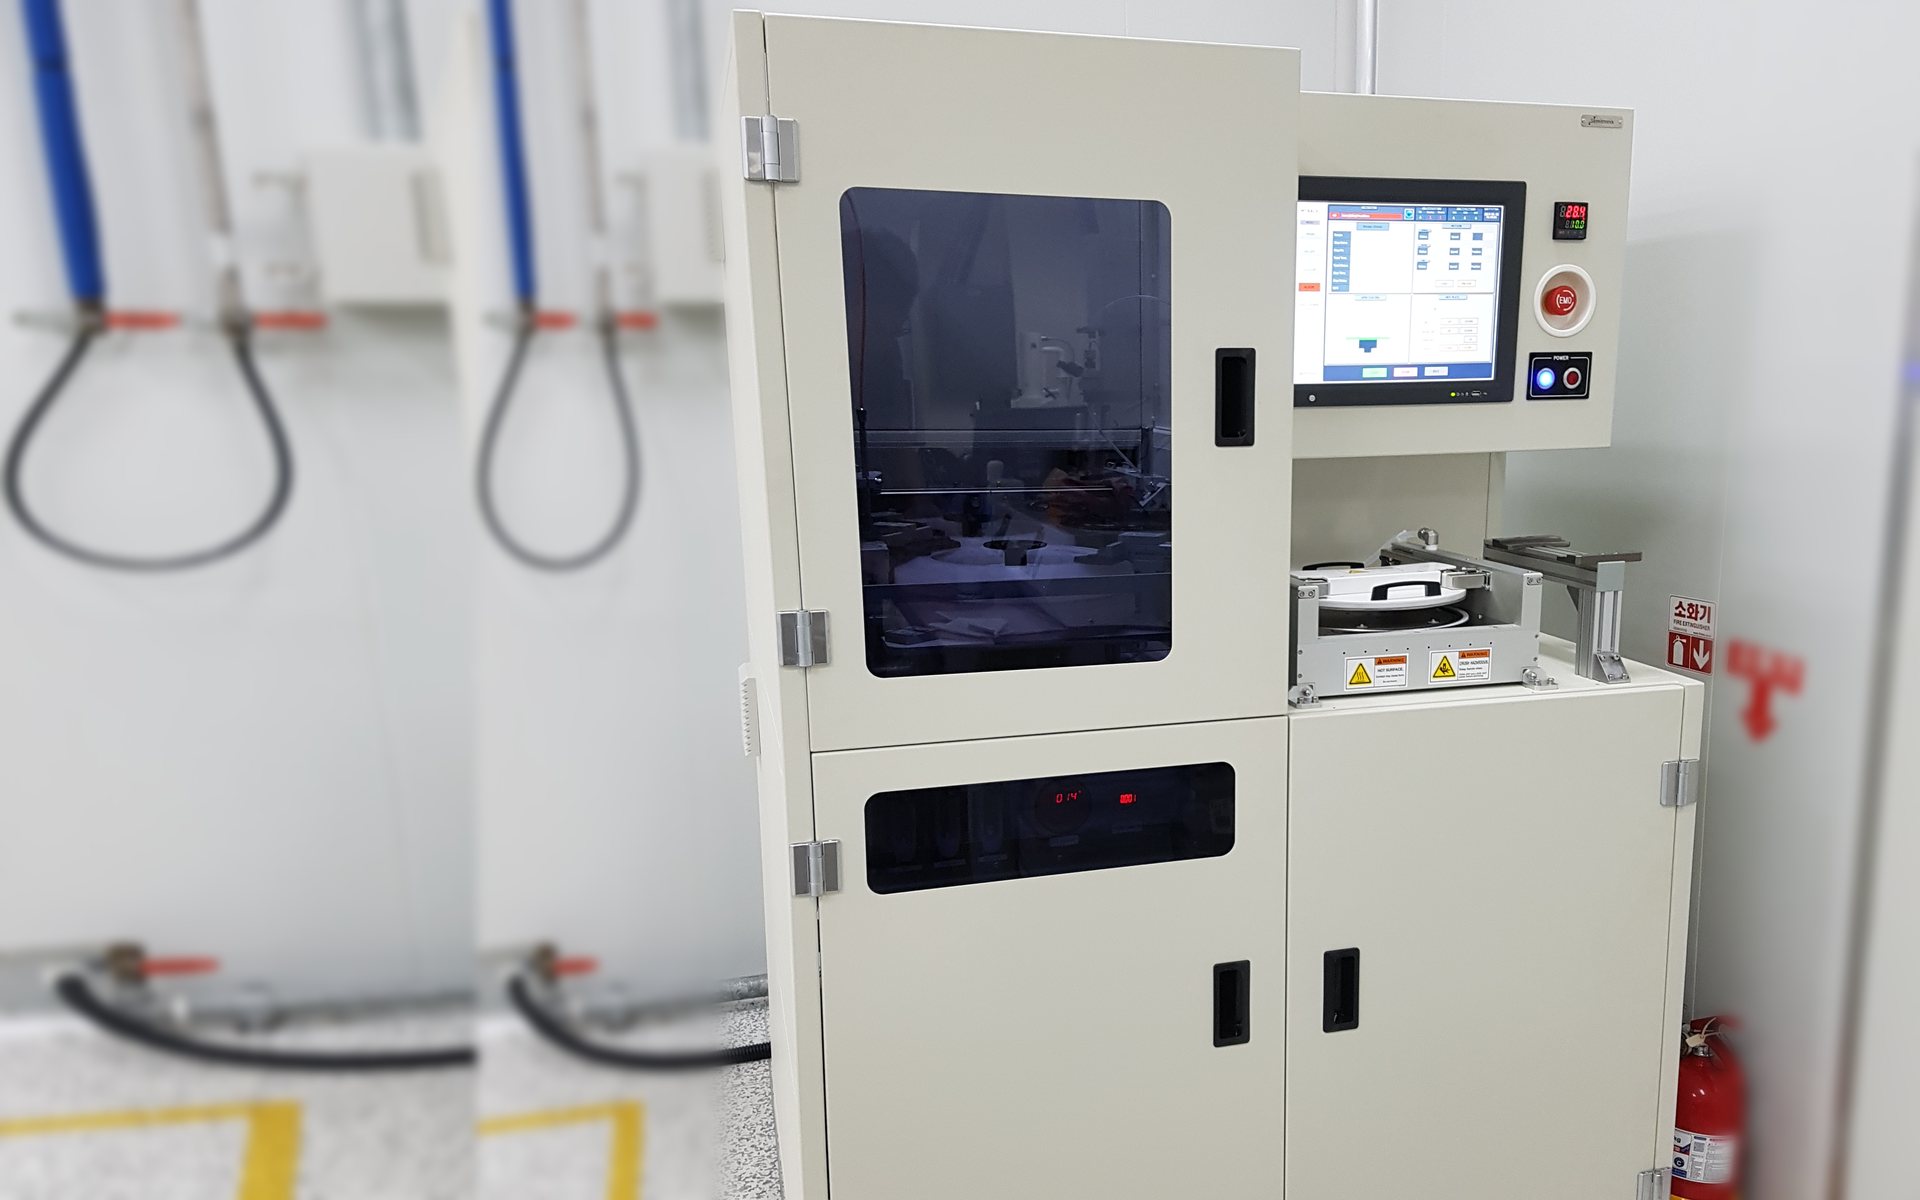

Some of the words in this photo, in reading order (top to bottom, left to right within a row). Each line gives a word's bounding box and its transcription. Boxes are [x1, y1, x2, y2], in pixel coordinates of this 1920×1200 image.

[1559, 296, 1572, 304] EMO
[1675, 601, 1711, 624] 소화기
[1683, 621, 1710, 631] EXTINGUISHER
